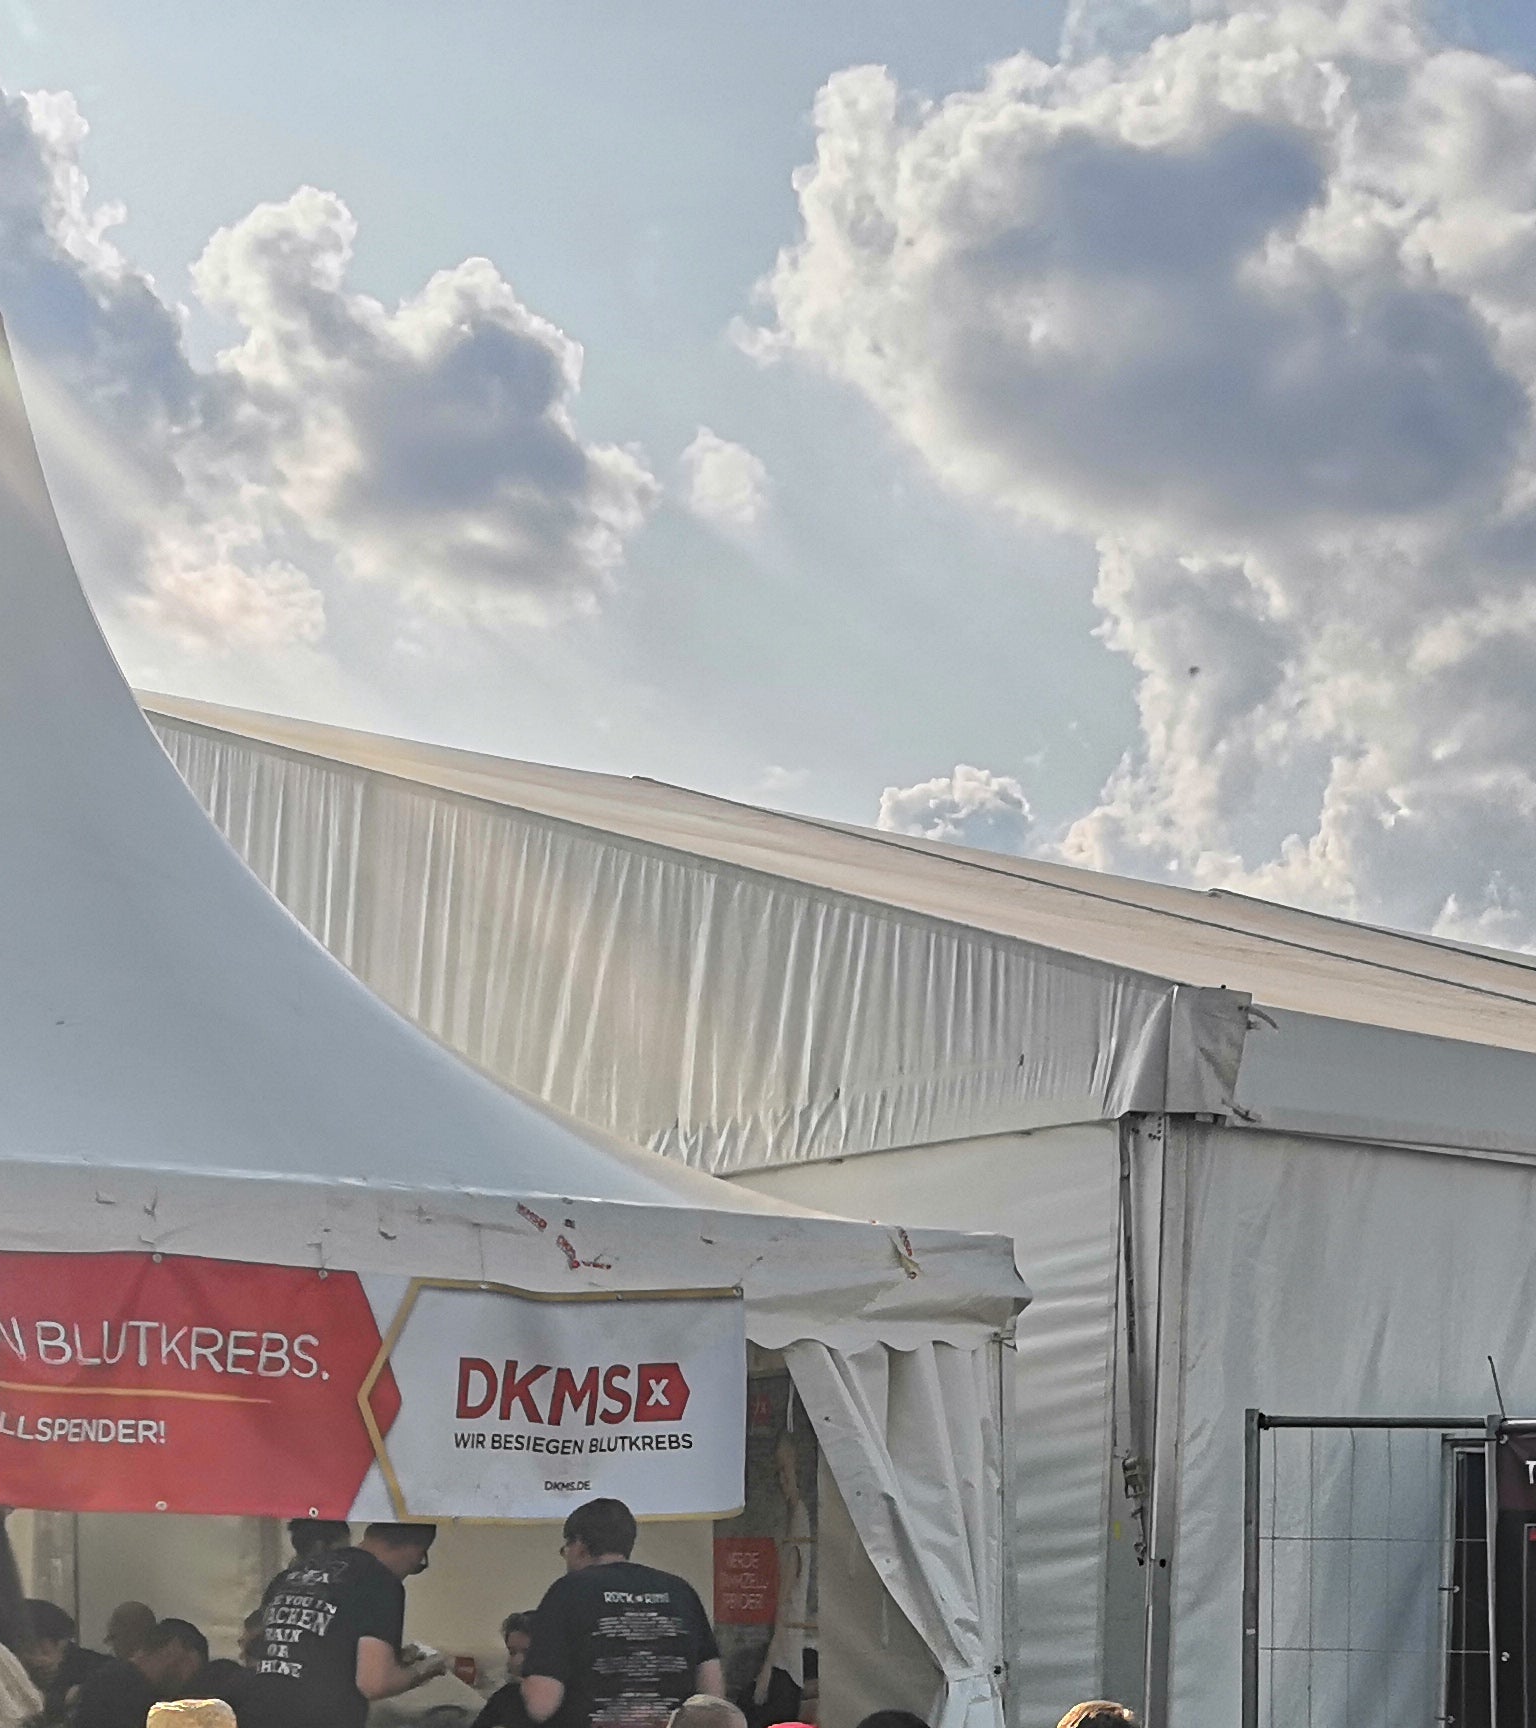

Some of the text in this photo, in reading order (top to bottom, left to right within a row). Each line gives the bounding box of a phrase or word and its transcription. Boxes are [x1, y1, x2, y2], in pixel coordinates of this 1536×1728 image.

[35, 1319, 331, 1382] BLUTKREBS.
[456, 1357, 632, 1426] DKMS
[454, 1432, 693, 1455] WIR BESIEGEN BLUTKREBS
